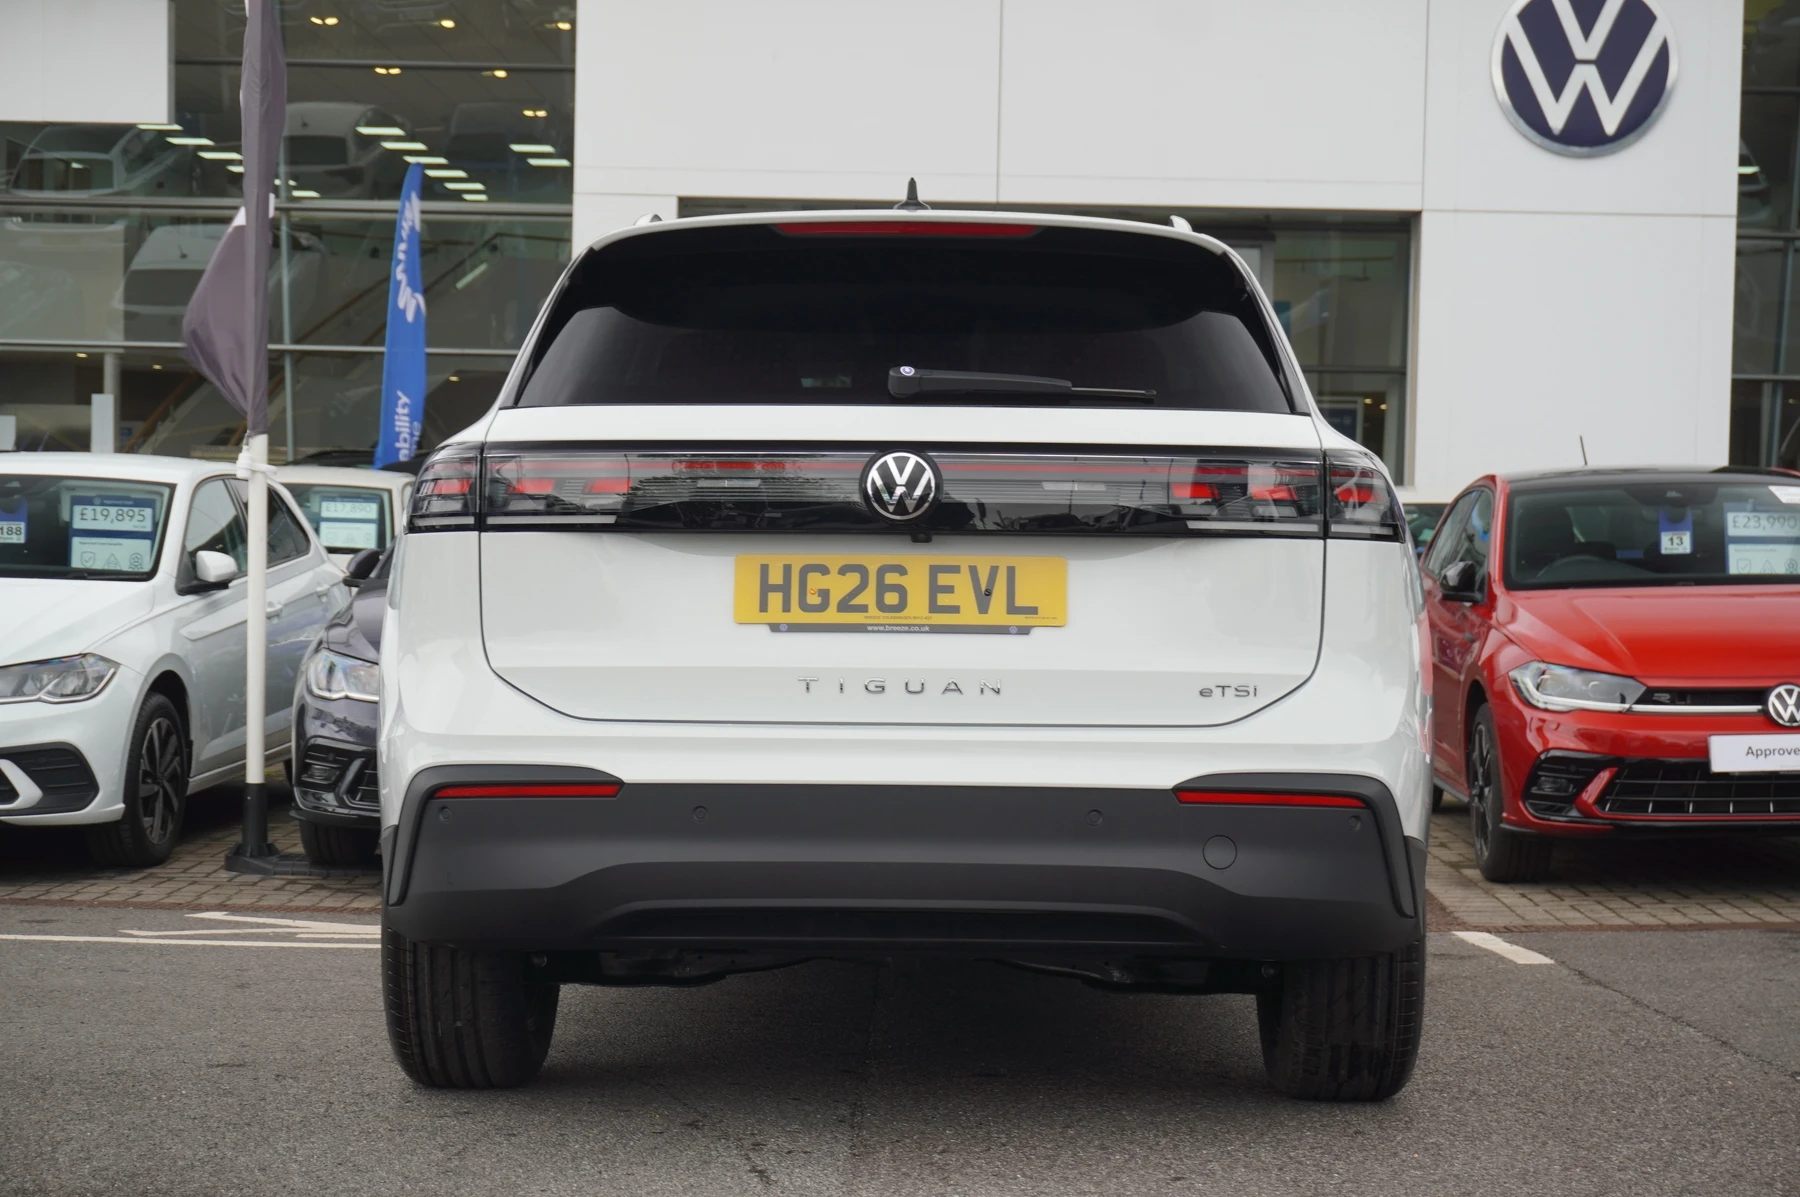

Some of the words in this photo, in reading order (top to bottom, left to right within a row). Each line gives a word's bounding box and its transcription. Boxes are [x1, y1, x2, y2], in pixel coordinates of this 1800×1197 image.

[869, 453, 934, 517] VW
[79, 507, 146, 524] £19,895
[1732, 515, 1798, 531] £23,990
[1667, 536, 1684, 546] 13
[759, 563, 908, 614] HG26
[928, 564, 1039, 615] EVL
[867, 624, 930, 632] www.breeze.co.uk
[797, 676, 1001, 696] TIGUAN
